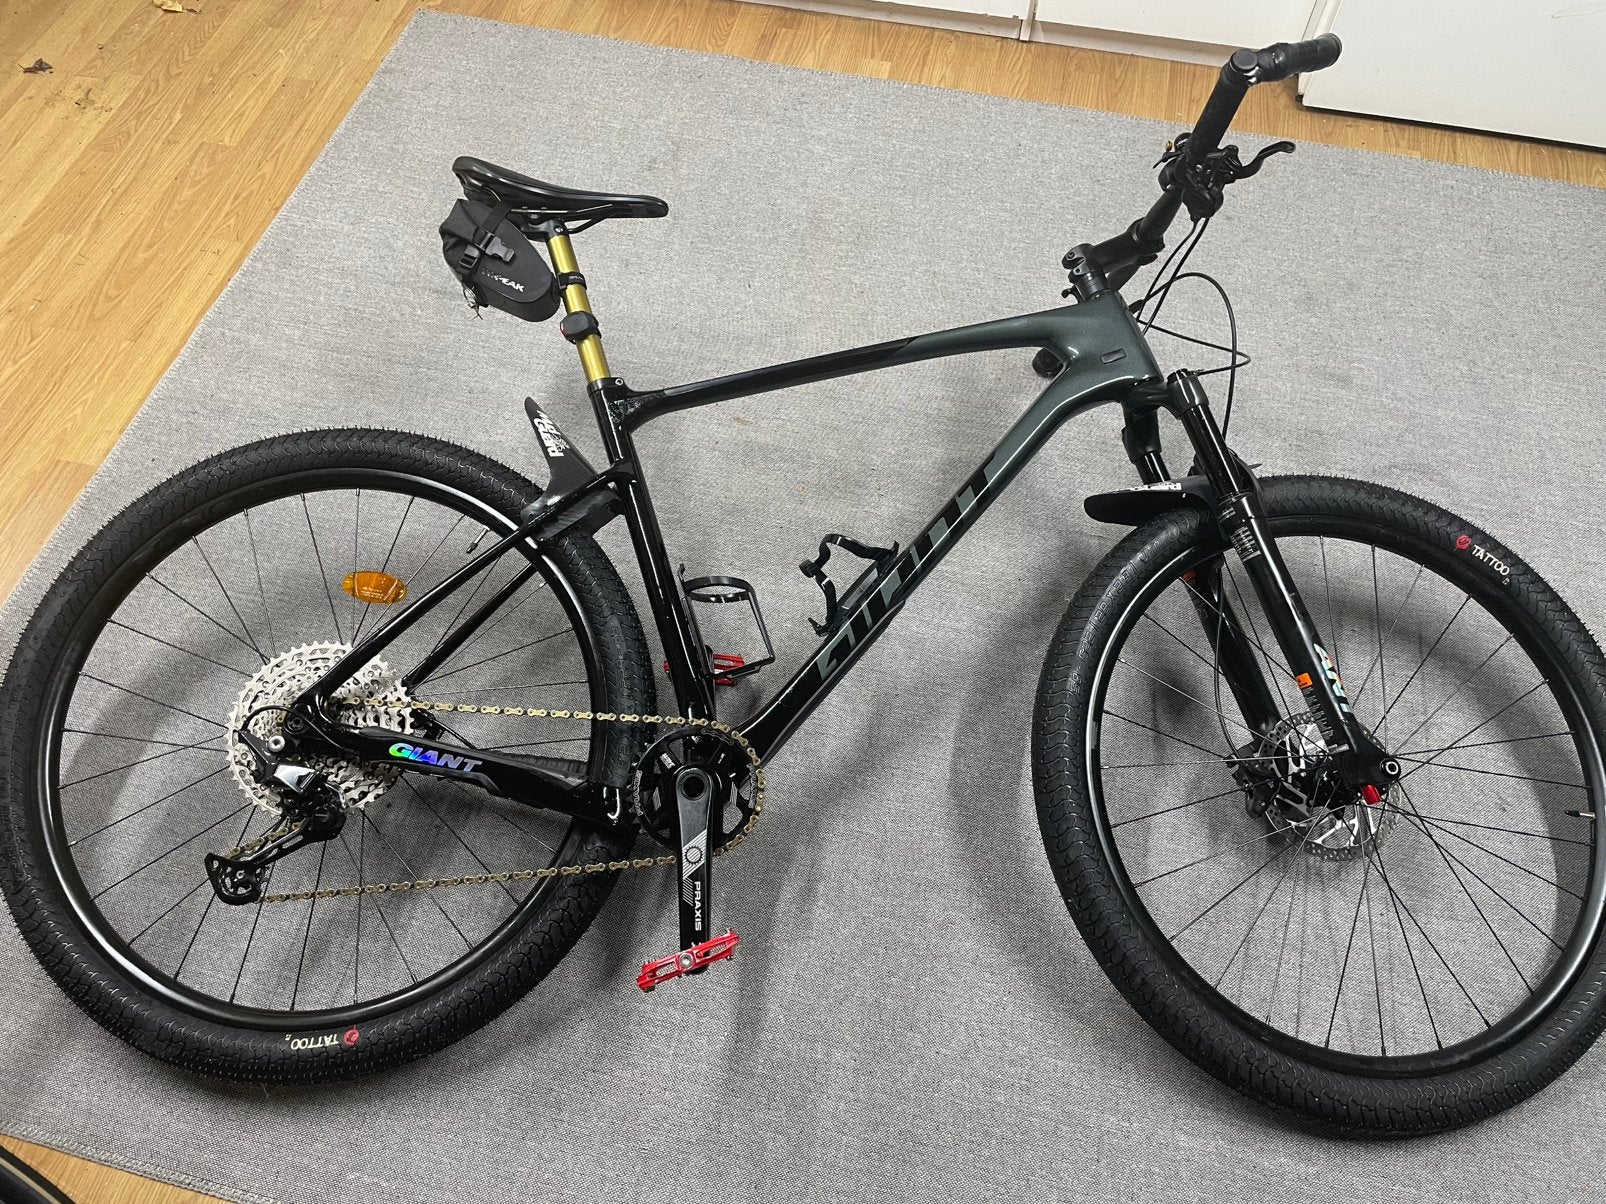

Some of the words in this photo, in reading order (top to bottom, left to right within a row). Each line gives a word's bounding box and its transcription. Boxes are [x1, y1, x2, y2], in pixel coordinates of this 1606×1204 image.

[1471, 544, 1510, 576] TATTOO
[388, 743, 482, 772] GIANT
[694, 881, 702, 931] PRAXIS
[290, 1034, 339, 1050] TATTOO
